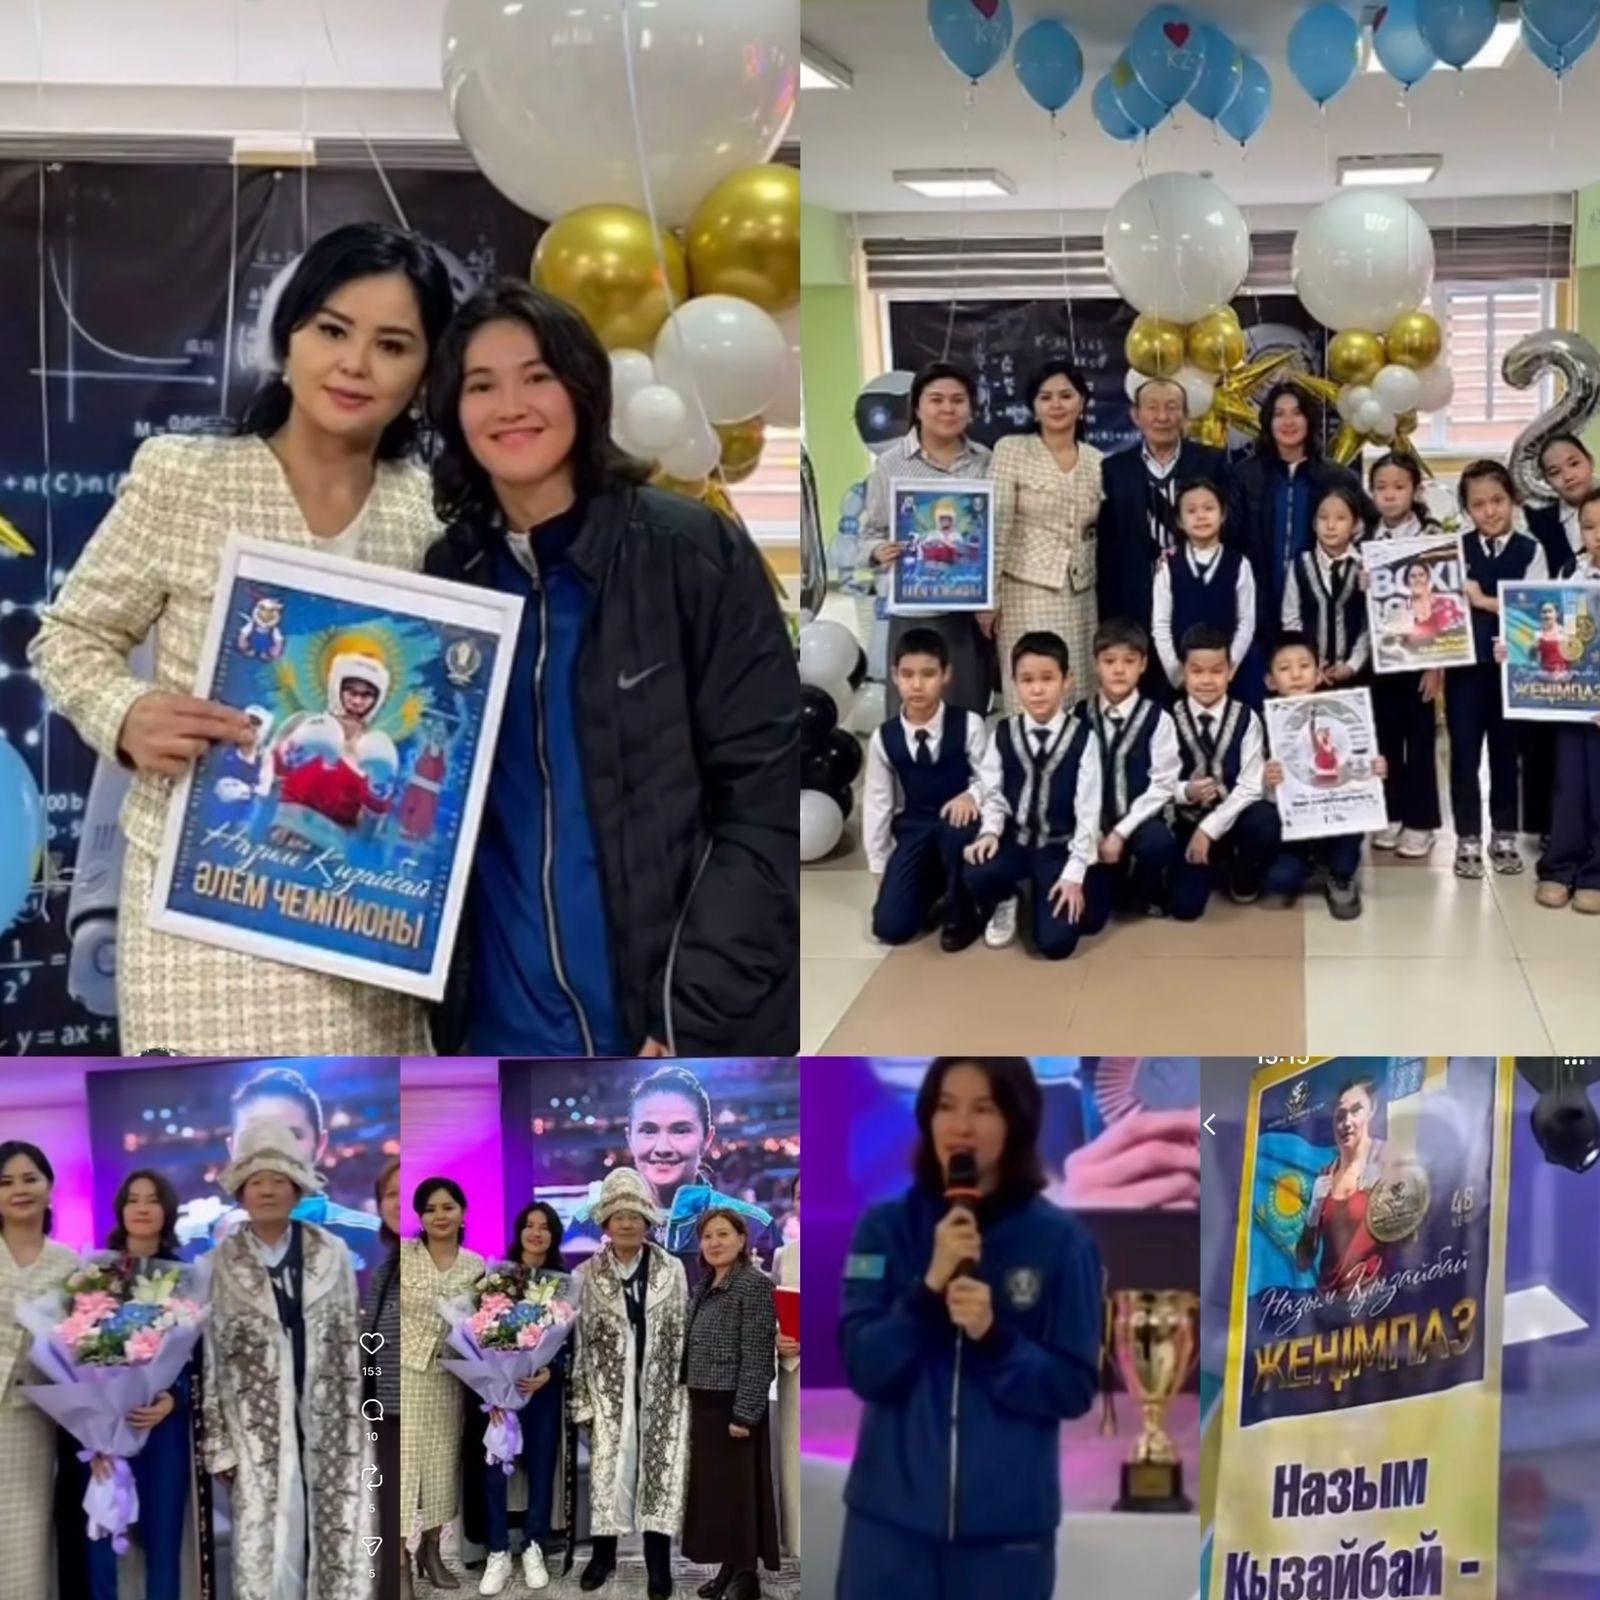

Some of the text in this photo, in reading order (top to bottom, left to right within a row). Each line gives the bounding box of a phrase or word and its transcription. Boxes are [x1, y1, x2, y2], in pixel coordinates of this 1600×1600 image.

[192, 860, 264, 910] ӘЛЕМ
[272, 879, 424, 949] ЧЕМПИОНЫ
[1253, 1297, 1478, 1396] ЖЕҢІМПАЗ
[1272, 1457, 1428, 1518] Назым
[1223, 1529, 1443, 1600] Кызайбай
